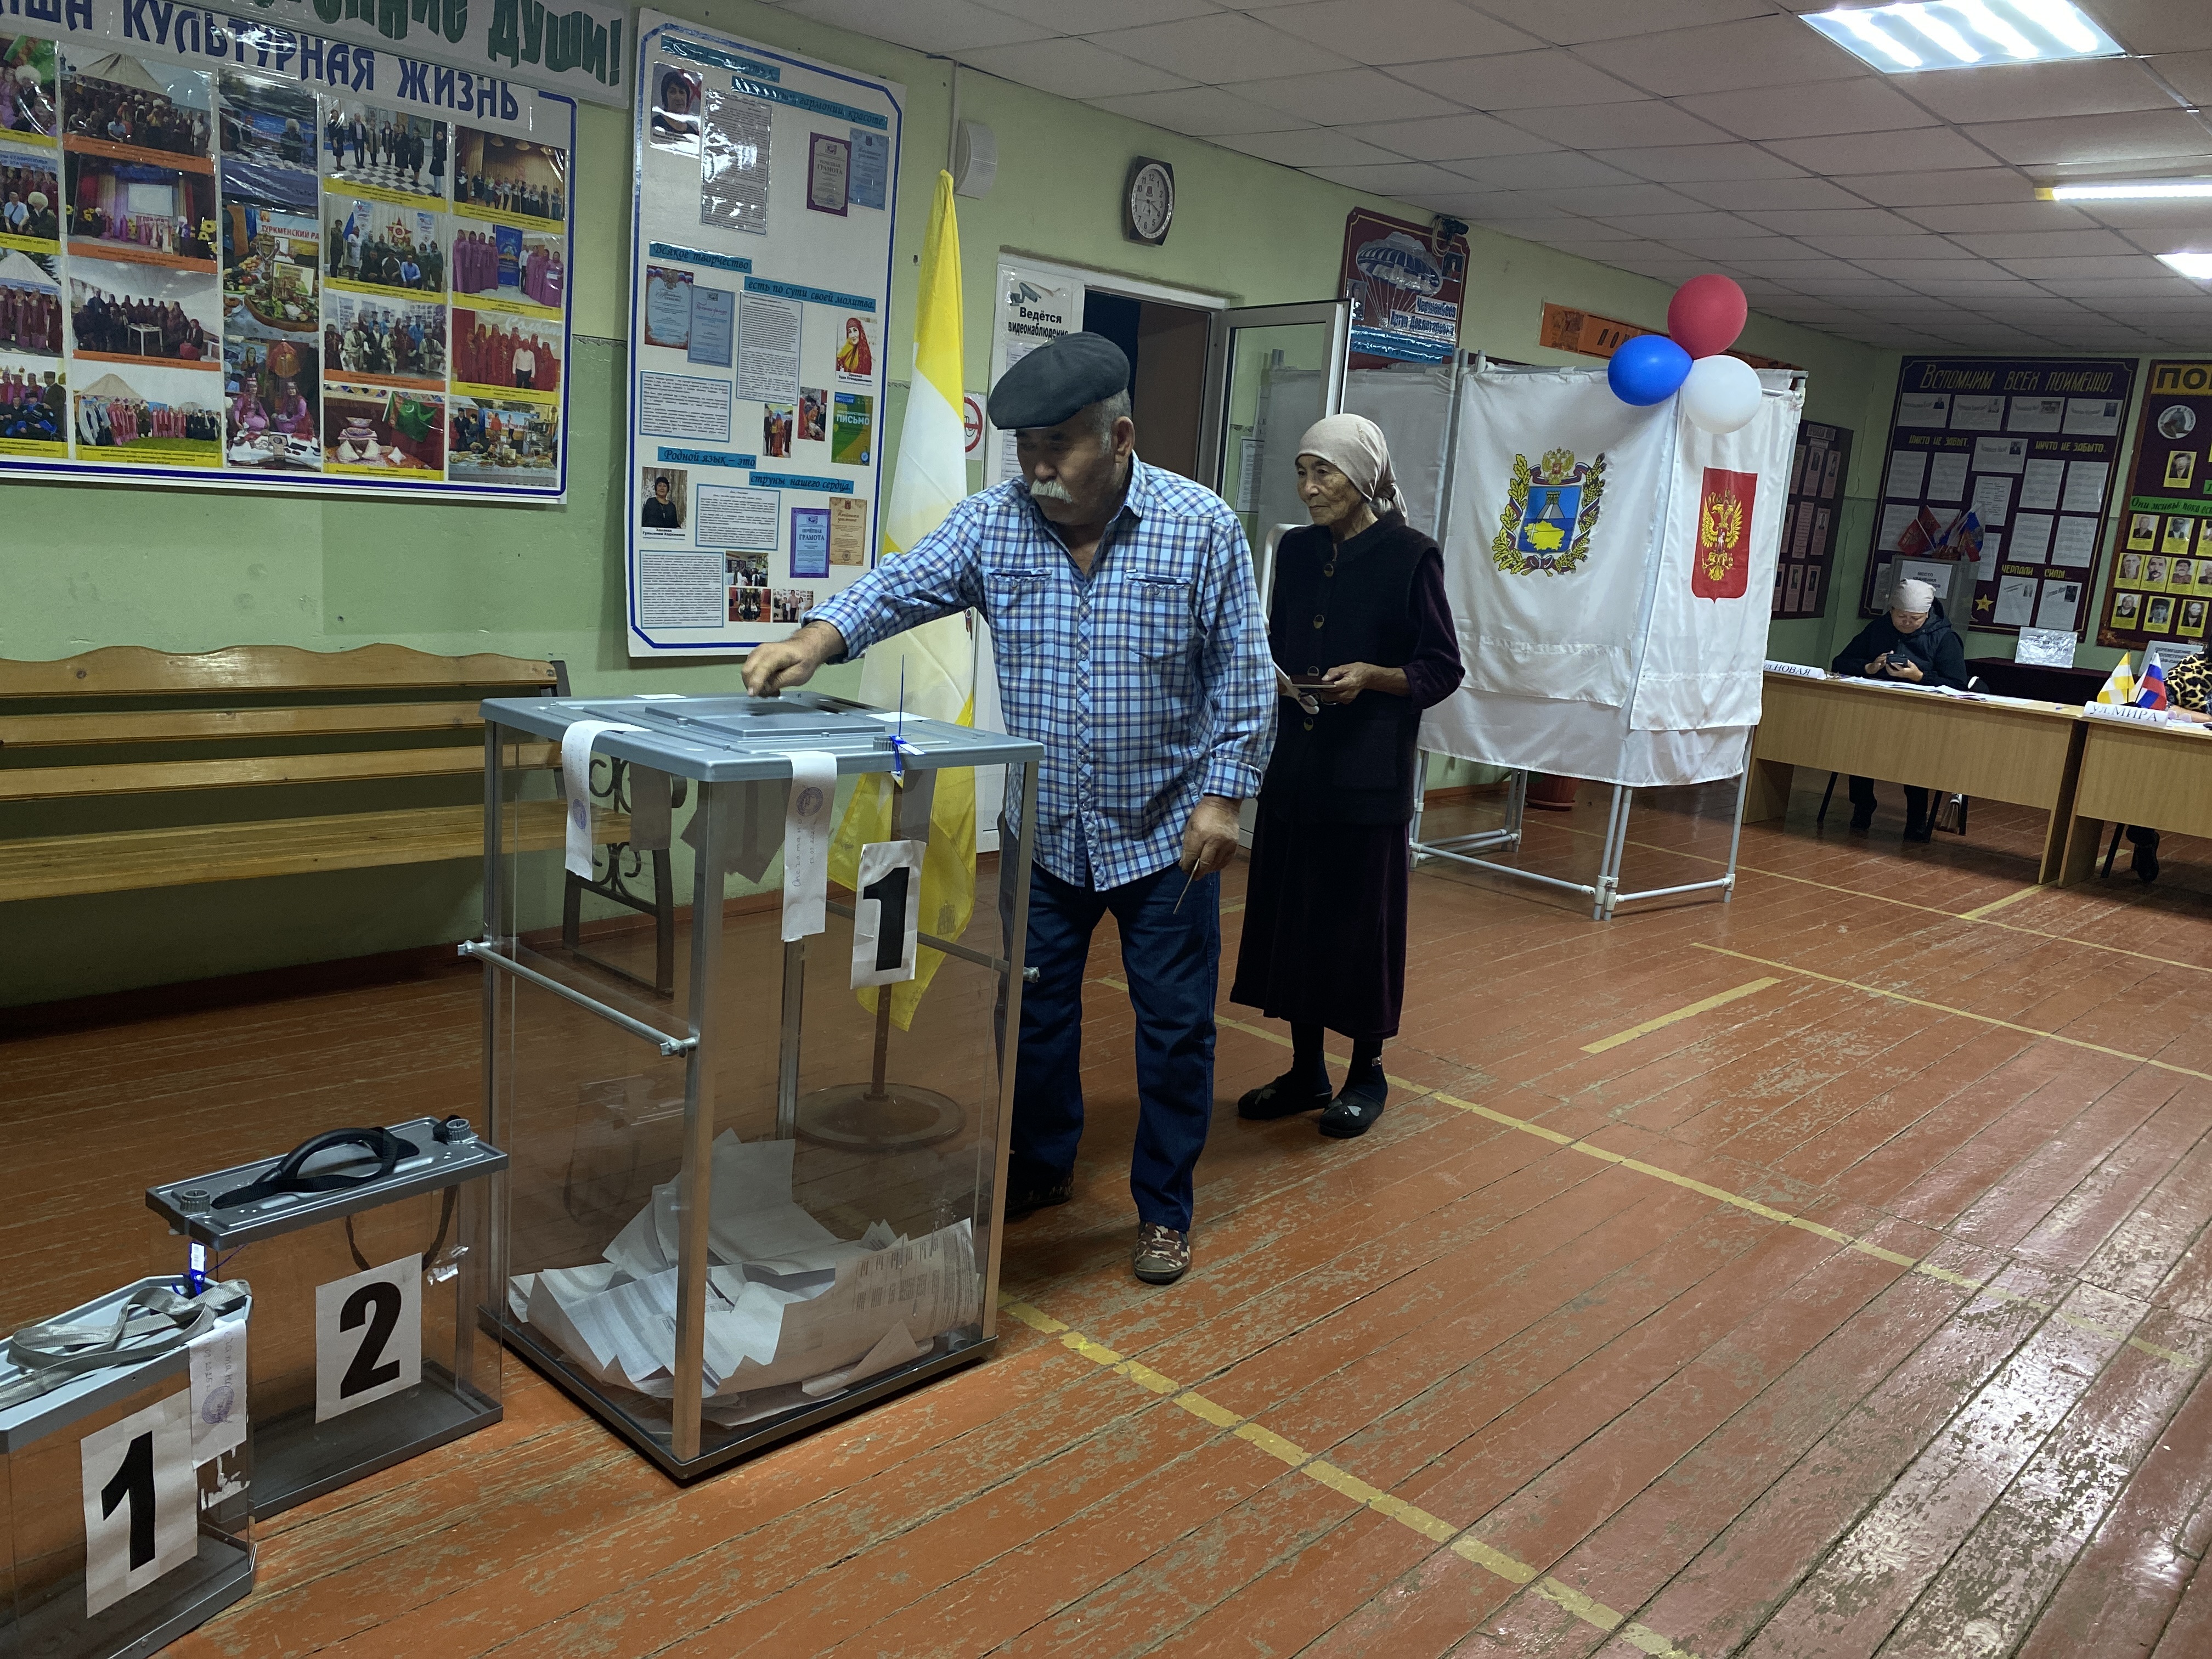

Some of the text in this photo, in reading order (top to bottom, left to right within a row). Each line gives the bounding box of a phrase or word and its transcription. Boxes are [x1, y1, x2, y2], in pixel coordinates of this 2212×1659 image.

[488, 0, 622, 87] ДУШИ!
[123, 0, 375, 93] КУЛЬТУРНАЯ
[396, 58, 519, 121] ЖИЗНЬ
[817, 164, 843, 175] ГРАМОТА
[1149, 173, 1155, 182] 12
[1141, 176, 1146, 184] 11
[653, 243, 749, 270] Всякое творчество
[748, 280, 875, 309] есть по сути своей молитва.
[1019, 307, 1062, 324] Ведётся
[2004, 371, 2041, 391] ВСЕХ
[2045, 371, 2114, 393] ПОИМЕННО.
[2156, 368, 2212, 390] ПО
[837, 414, 870, 426] ПИСЬМО
[1909, 434, 1931, 445] НИКТО
[1933, 436, 1943, 445] НЕ
[2035, 441, 2058, 450] НИЧТО
[2061, 442, 2071, 451] НЕ
[663, 449, 700, 462] Родной
[702, 454, 729, 467] язык
[737, 458, 756, 467] это
[750, 474, 786, 488] струны
[790, 478, 821, 489] нашего
[2131, 496, 2150, 509] Они
[2182, 502, 2200, 512] пока
[2002, 563, 2034, 576] ЧЕРПАЛИ
[2090, 705, 2158, 722] ул.МИРА
[862, 866, 911, 972] 1
[340, 1281, 402, 1400] 2
[100, 1430, 156, 1572] 1
